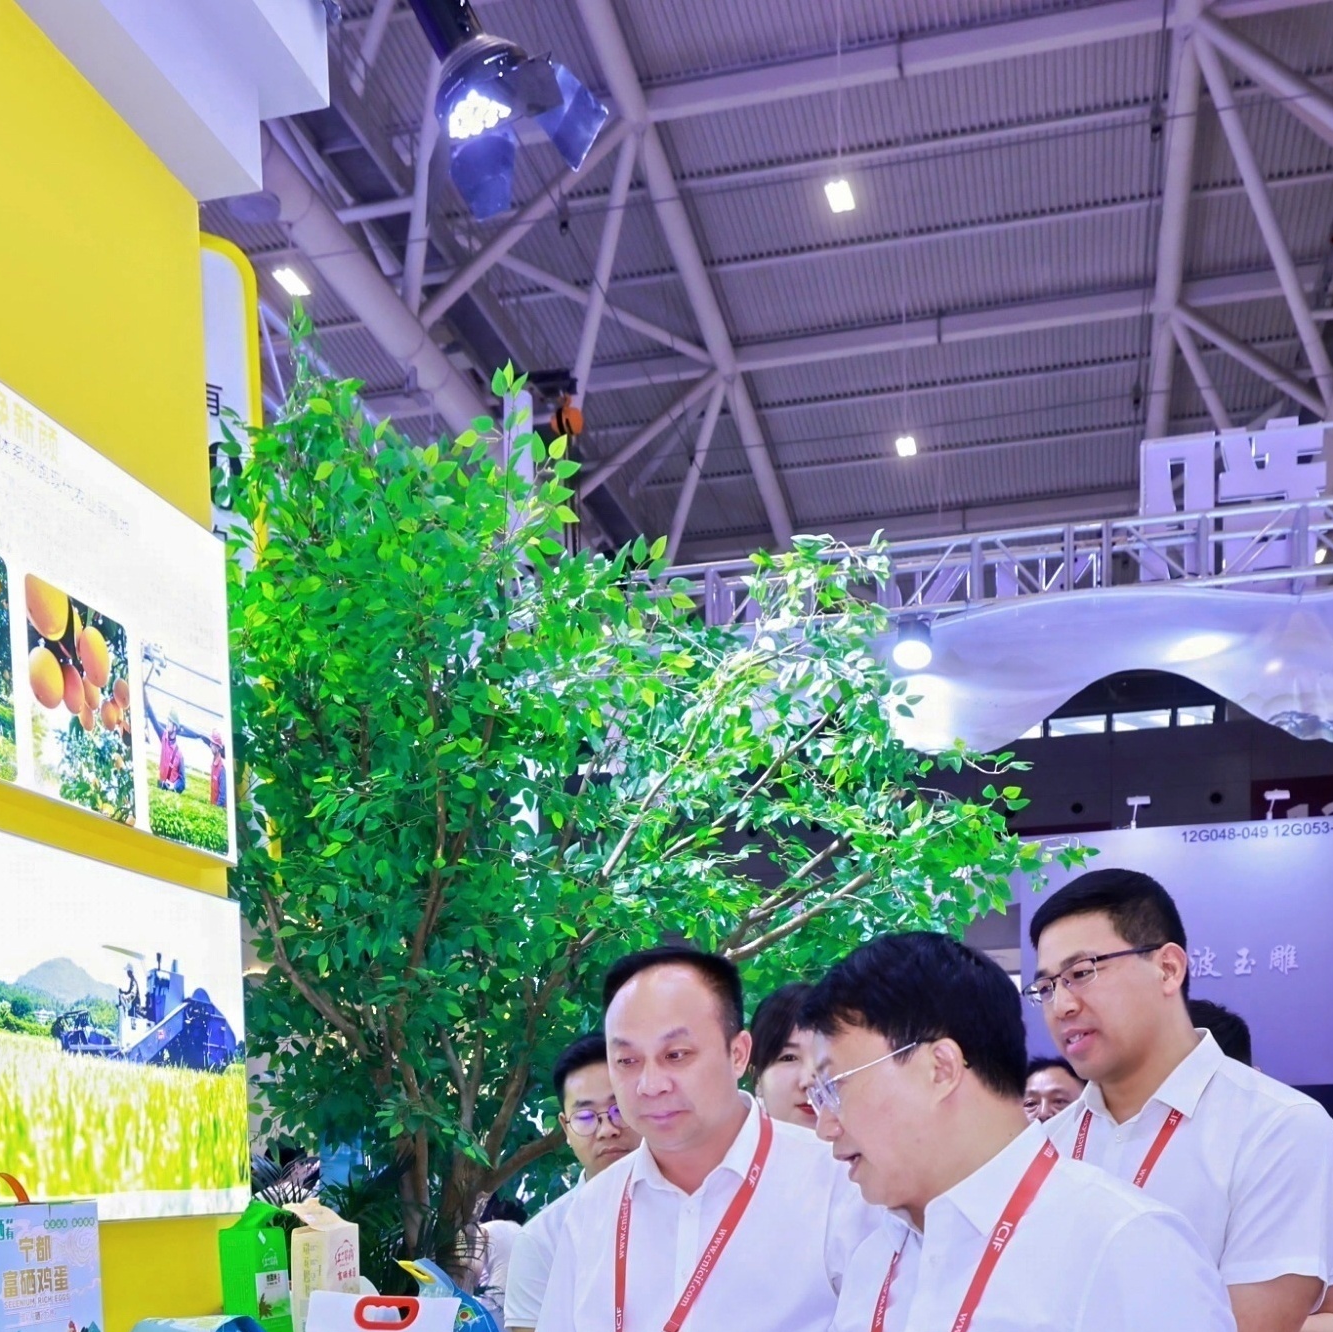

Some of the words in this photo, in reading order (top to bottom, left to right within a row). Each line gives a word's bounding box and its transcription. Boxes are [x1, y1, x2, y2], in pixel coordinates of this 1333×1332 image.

[1182, 826, 1268, 843] 12G048-049
[750, 1163, 761, 1188] ICIF
[19, 1235, 51, 1262] 宁都
[994, 1221, 1013, 1252] ICIF
[2, 1265, 68, 1298] 富硒鸡蛋
[680, 1228, 728, 1308] www.cnicif.com
[4, 1299, 35, 1309] SELENIUM
[54, 1294, 70, 1302] EGGS
